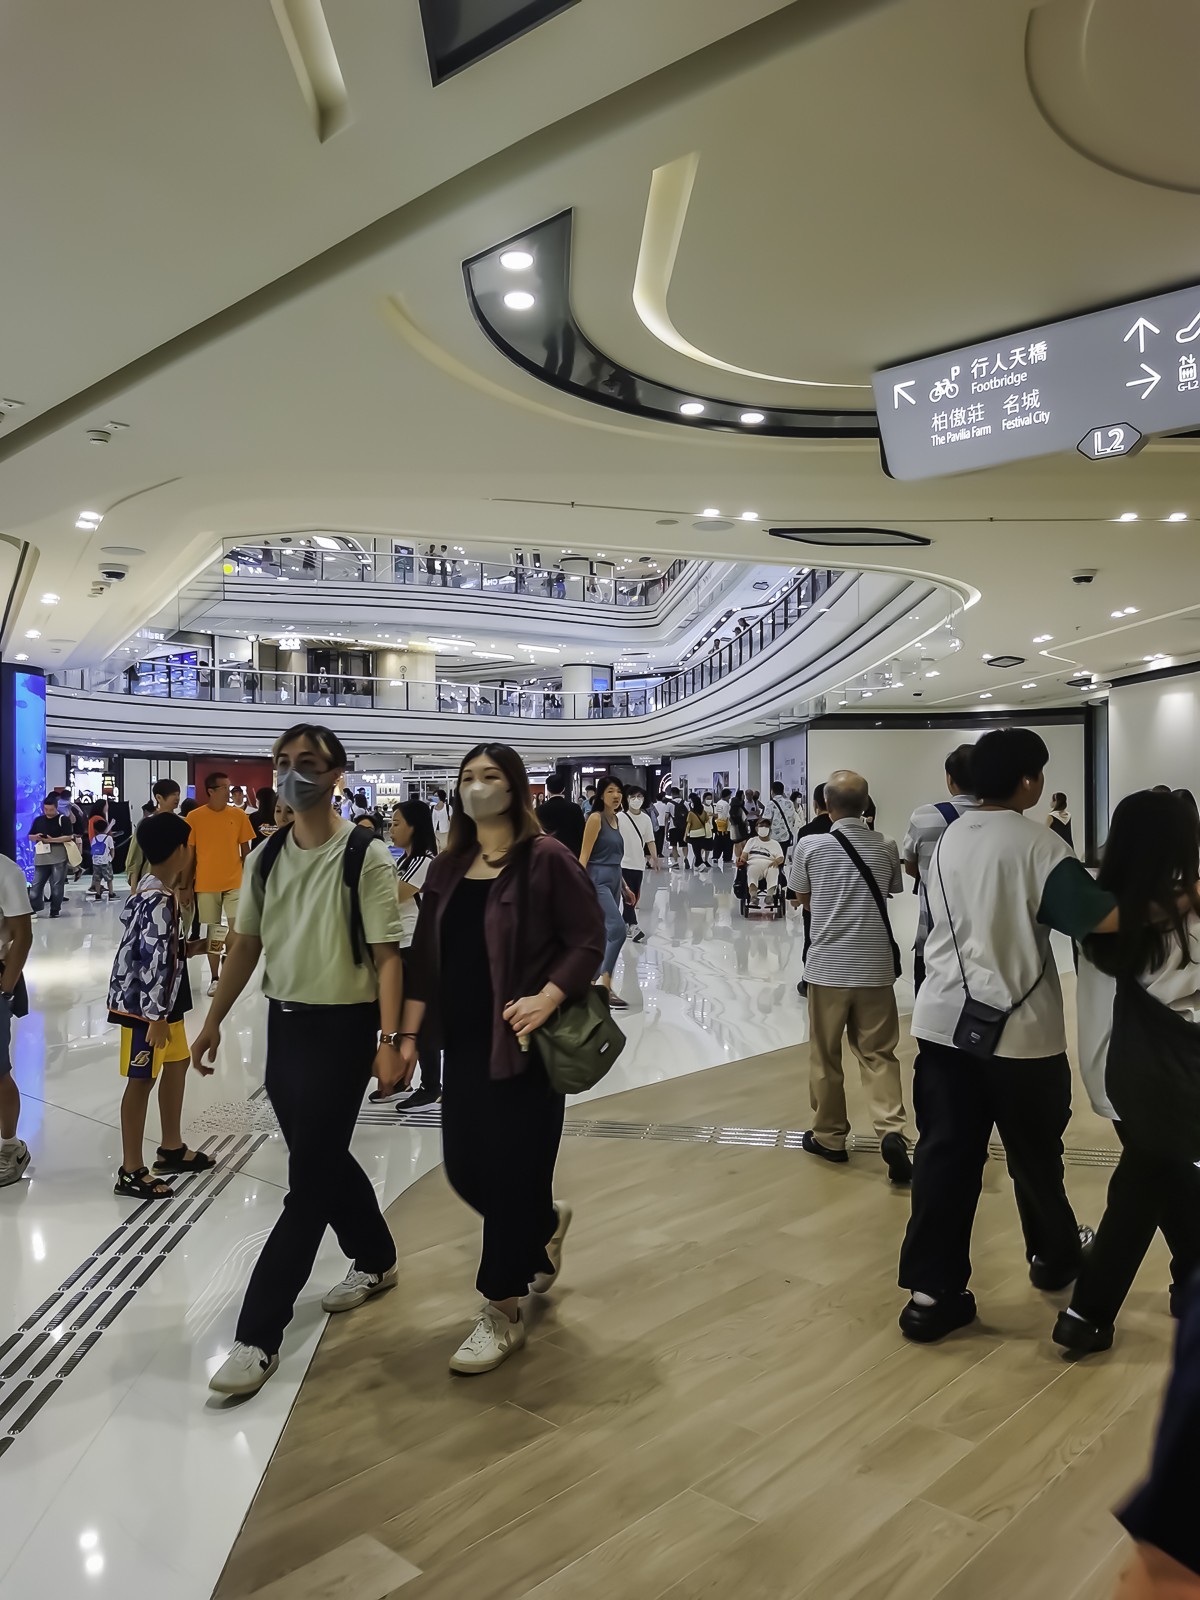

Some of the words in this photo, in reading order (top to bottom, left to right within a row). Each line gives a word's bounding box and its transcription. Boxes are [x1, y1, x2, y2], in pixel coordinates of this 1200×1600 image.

[971, 341, 1048, 379] 行人天橋
[951, 366, 960, 381] P
[971, 372, 1028, 394] Footbridge
[1177, 380, 1199, 392] G-L2
[1003, 389, 1041, 415] 名城
[931, 402, 985, 432] 柏傲莊
[1002, 413, 1032, 430] Festival
[1033, 411, 1051, 424] City
[931, 434, 946, 446] The
[946, 428, 971, 443] Pavilia
[971, 425, 992, 438] Farm
[1094, 428, 1125, 455] L2
